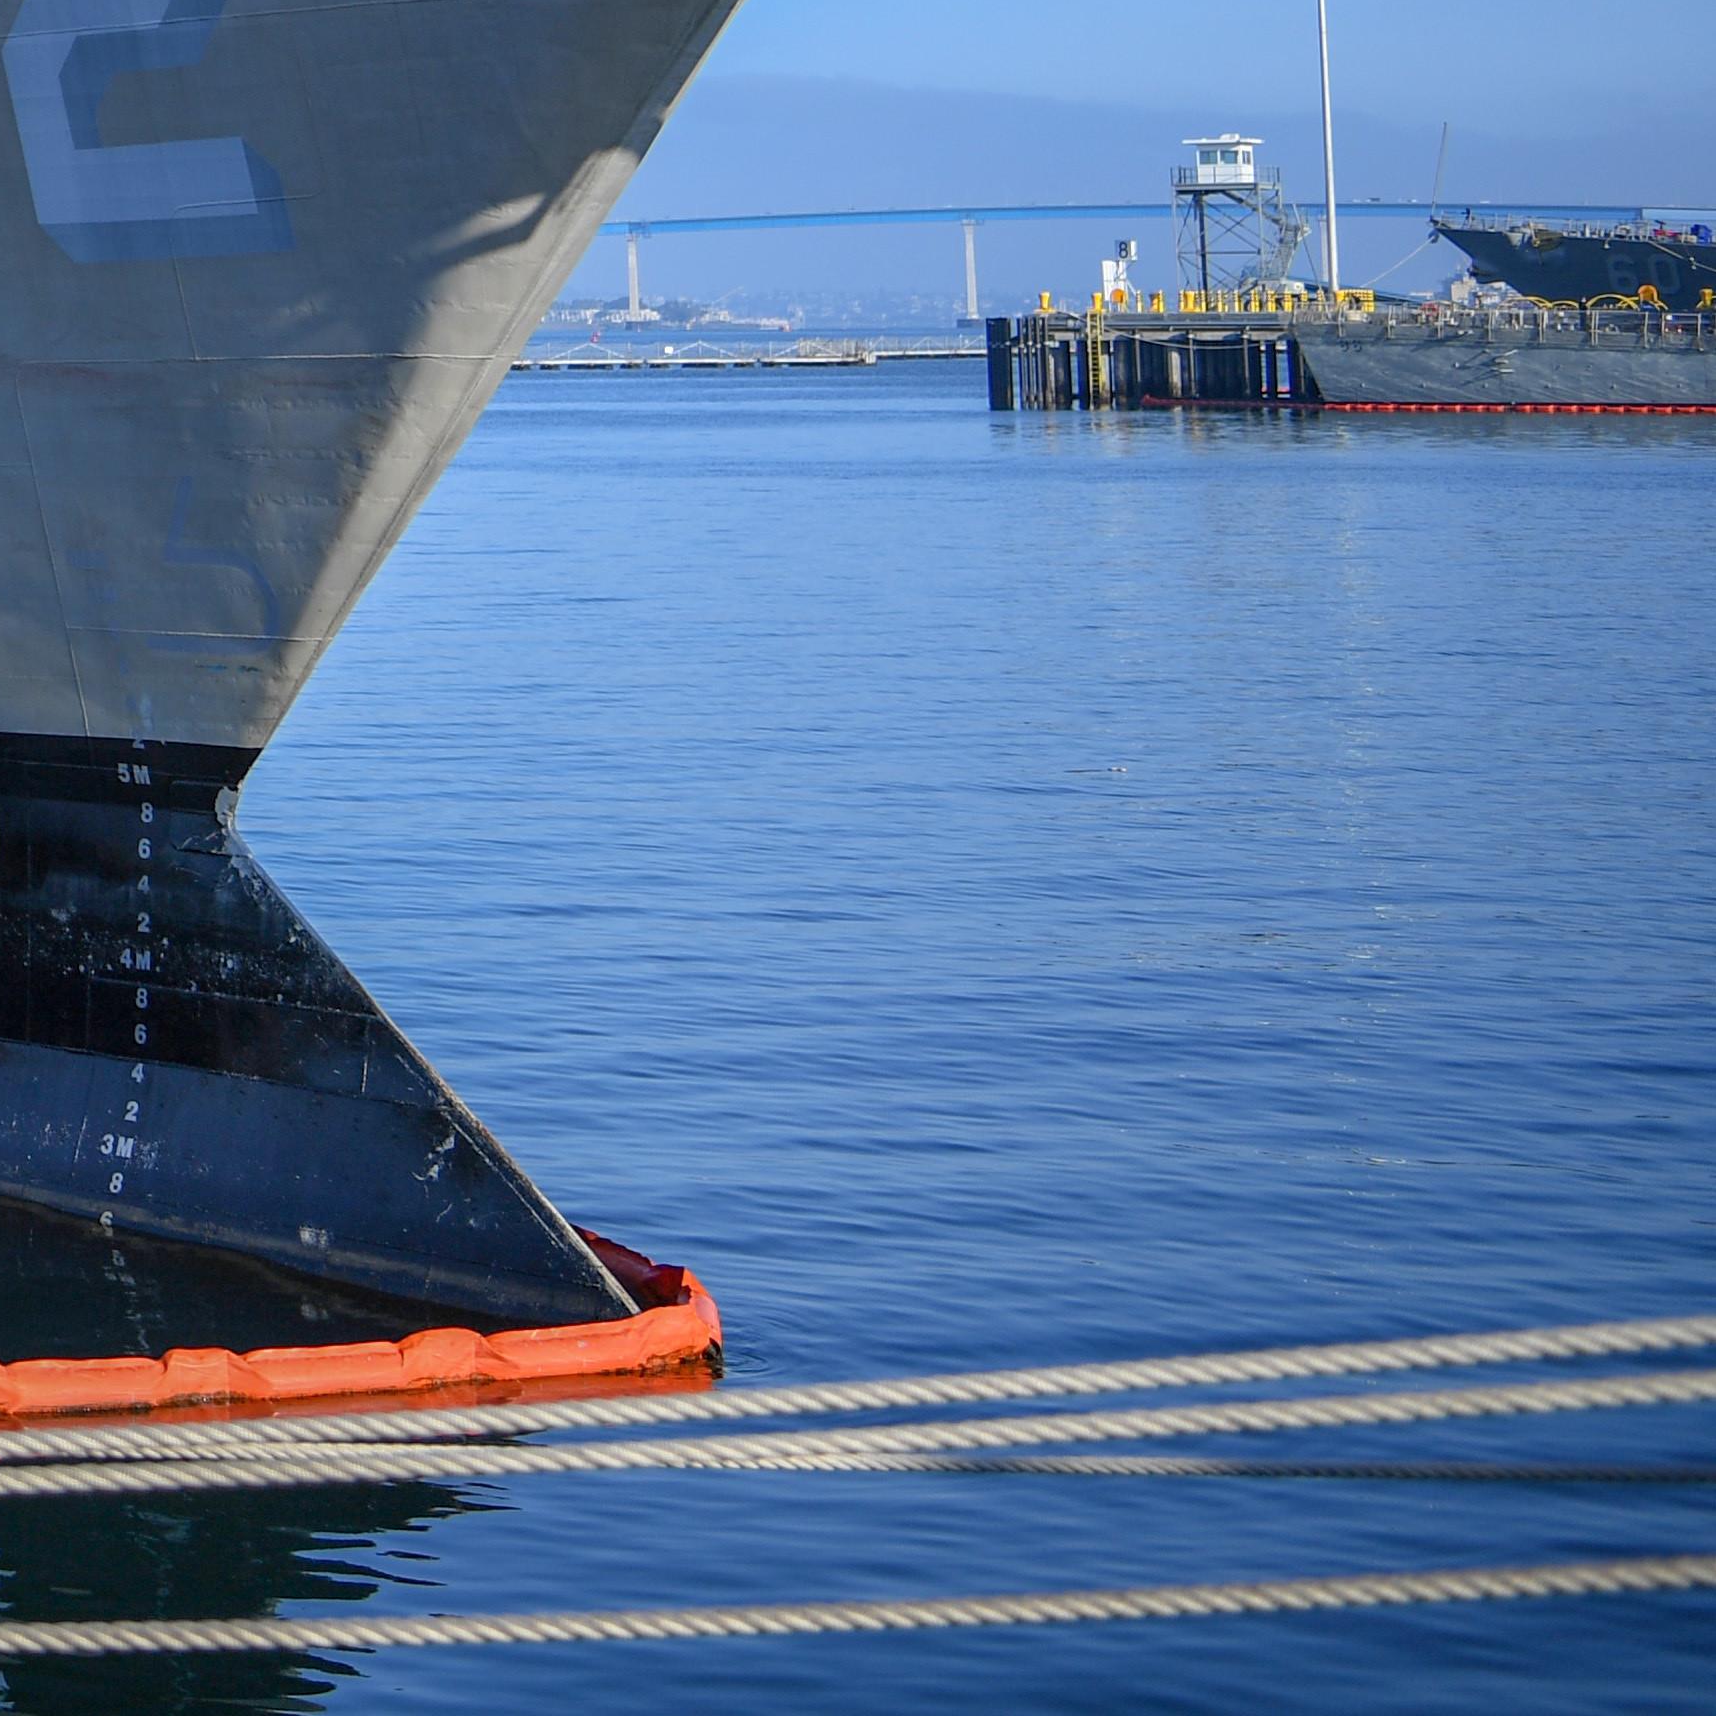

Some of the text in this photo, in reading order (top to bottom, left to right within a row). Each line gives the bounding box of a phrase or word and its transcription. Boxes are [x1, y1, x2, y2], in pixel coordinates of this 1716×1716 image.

[1118, 241, 1129, 259] 8
[1607, 253, 1681, 294] 60
[117, 763, 151, 785] 5M
[140, 802, 154, 823] 8
[138, 838, 151, 859] 6
[137, 875, 150, 895] 4
[137, 912, 151, 933] 2
[120, 947, 151, 971] 4M
[135, 988, 148, 1009] 8
[134, 1024, 147, 1044] 6
[131, 1063, 145, 1083] 4
[124, 1101, 139, 1122] 2
[100, 1133, 134, 1158] 3M
[109, 1172, 124, 1193] 8
